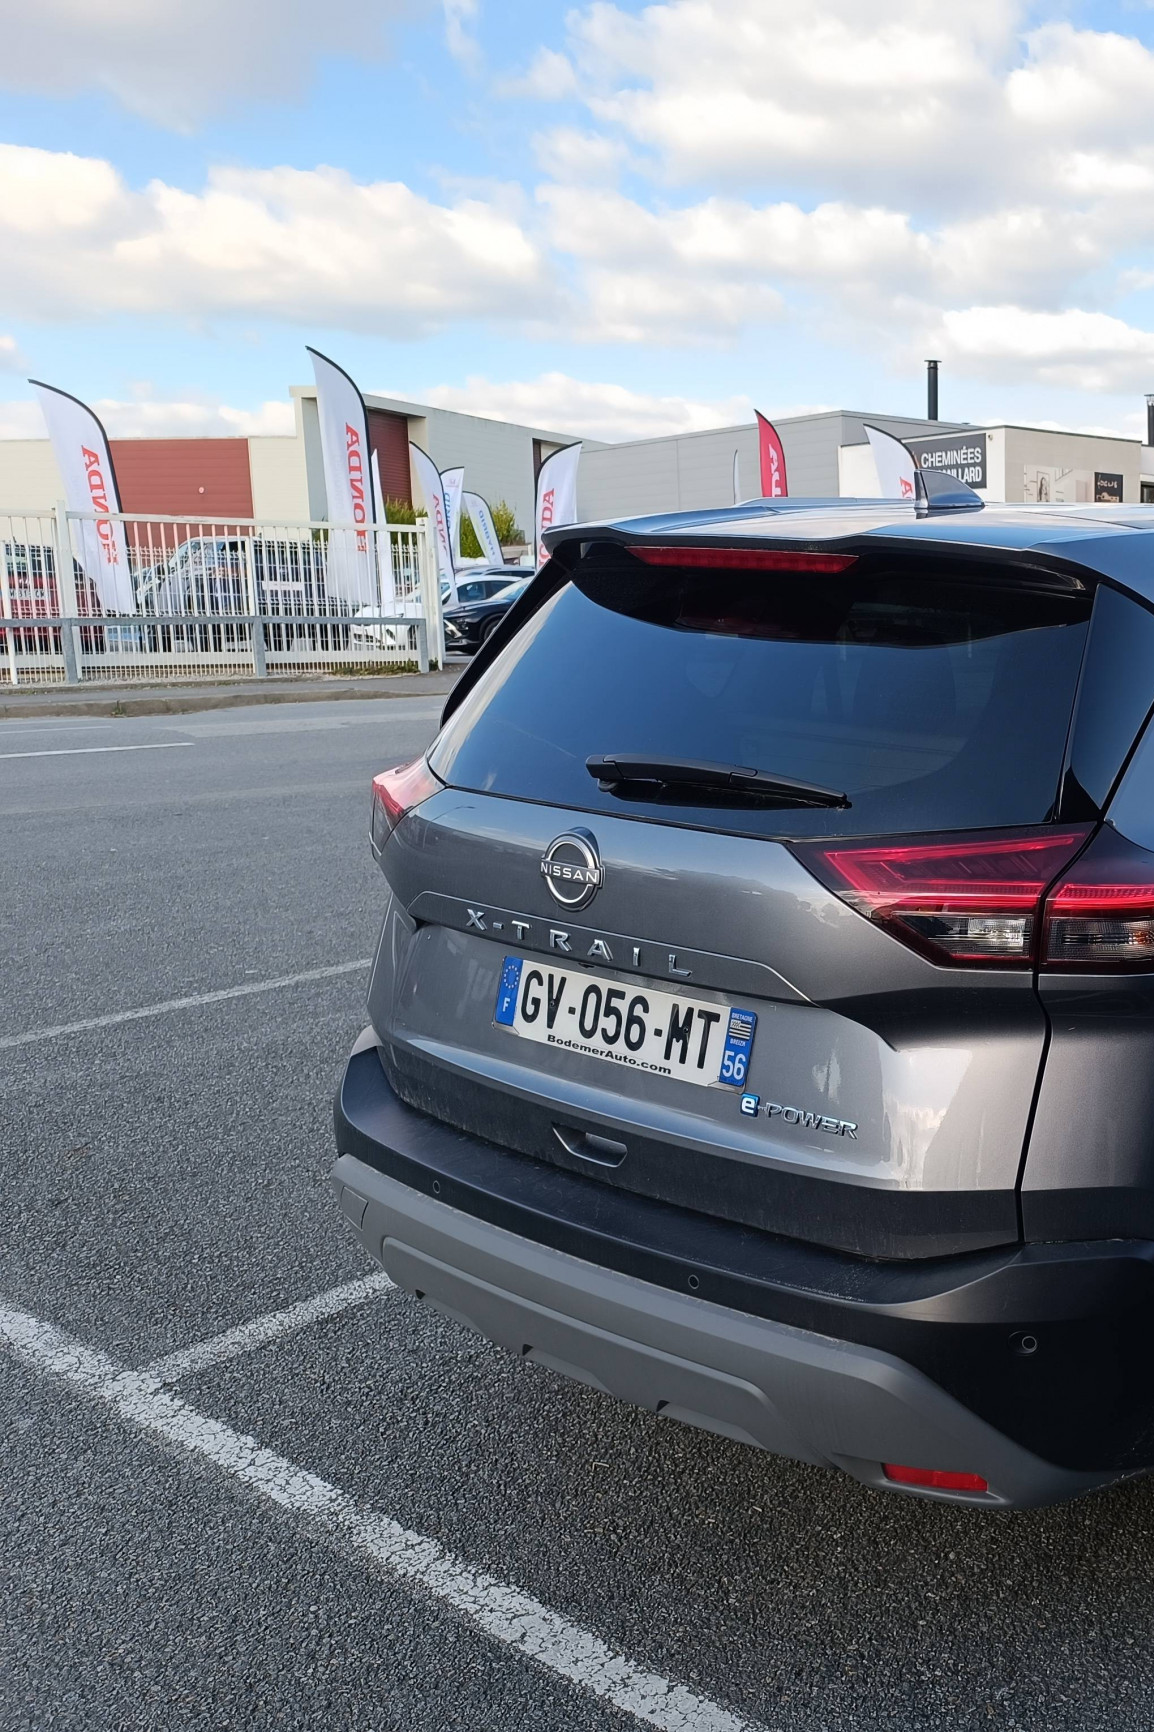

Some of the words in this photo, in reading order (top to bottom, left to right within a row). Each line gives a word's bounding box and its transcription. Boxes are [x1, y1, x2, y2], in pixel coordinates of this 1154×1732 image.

[921, 446, 982, 468] CHEMINÉES
[541, 861, 598, 883] NISSAN
[466, 908, 692, 978] X-TRAIL
[502, 997, 511, 1013] F
[521, 969, 721, 1069] GV-056-MT
[731, 1012, 753, 1023] BRETAGNE
[547, 1034, 672, 1075] BodemerAuto.com
[721, 1051, 747, 1080] 56
[741, 1096, 858, 1140] e-POWER
